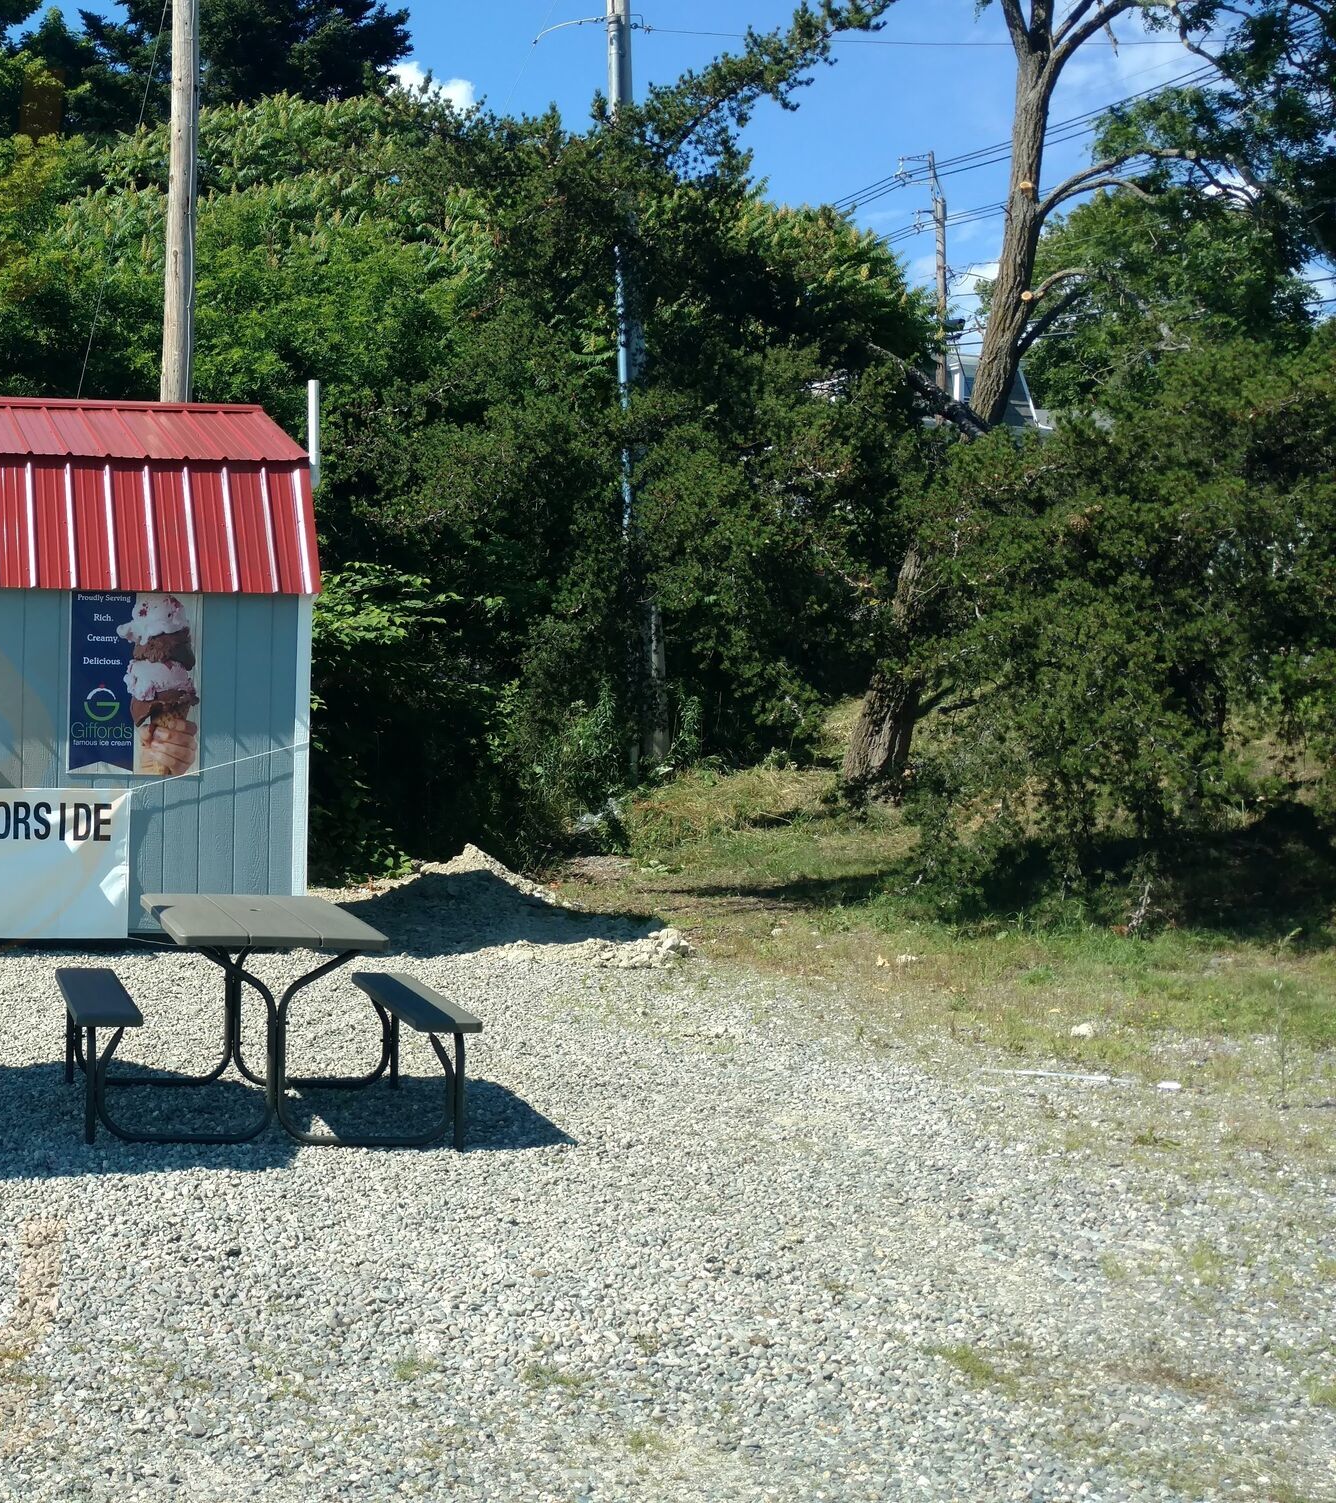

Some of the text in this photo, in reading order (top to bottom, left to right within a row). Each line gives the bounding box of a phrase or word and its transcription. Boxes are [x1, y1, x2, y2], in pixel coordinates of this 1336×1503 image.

[77, 593, 131, 603] Proudly Serving
[93, 613, 114, 622] Rich.
[87, 633, 120, 644] Creamy.
[83, 656, 123, 665] Delicious.
[71, 721, 133, 739] Gifford's
